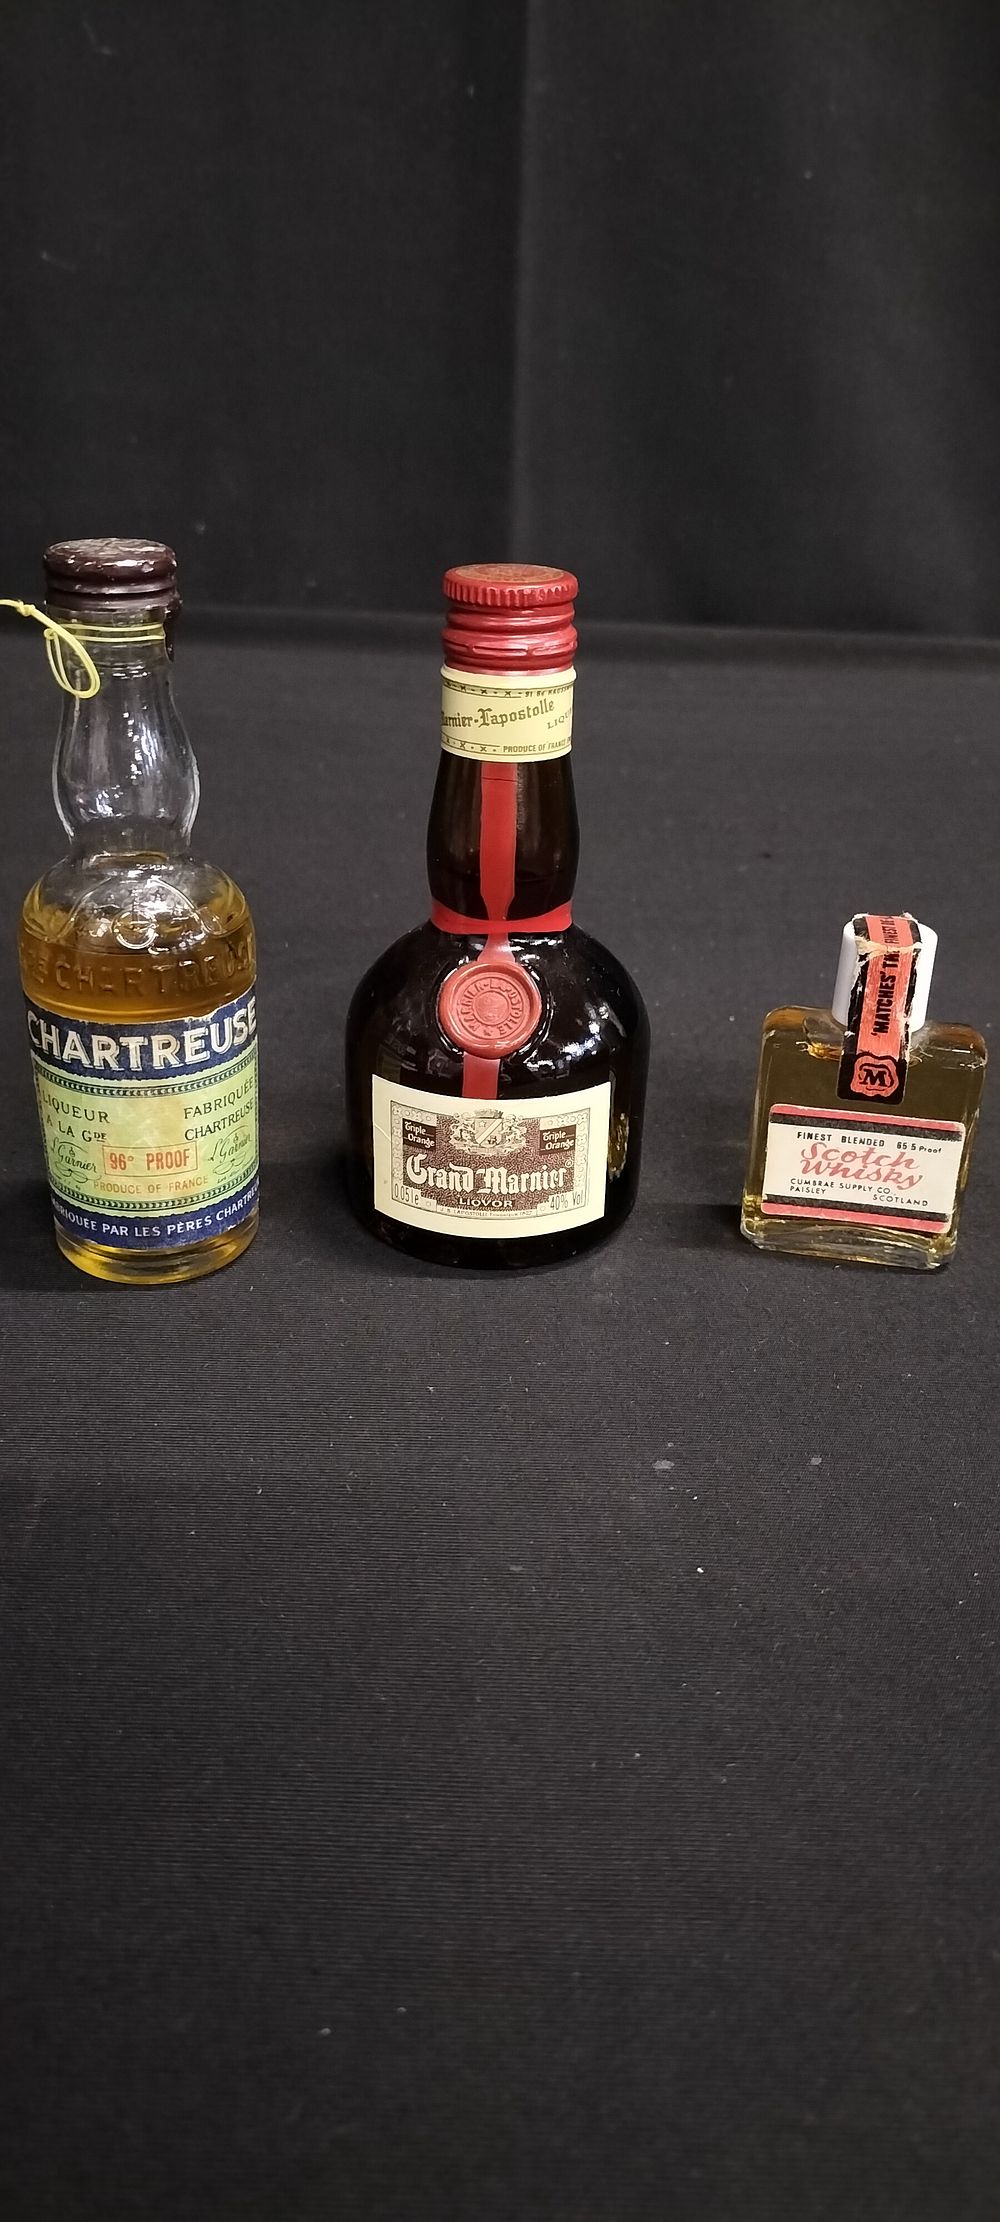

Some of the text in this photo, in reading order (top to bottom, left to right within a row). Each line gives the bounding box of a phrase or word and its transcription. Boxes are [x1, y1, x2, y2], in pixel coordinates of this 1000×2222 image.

[503, 744, 536, 753] PRODUCE
[538, 743, 546, 752] OF
[26, 998, 257, 1071] CHARTREUSE
[864, 1069, 887, 1087] M
[42, 1090, 110, 1124] LIQUEUR
[184, 1076, 254, 1120] FABRIQUÉE
[58, 1120, 75, 1138] LA
[184, 1097, 254, 1141] CHARTREUSE
[404, 1121, 427, 1136] Triple
[407, 1133, 436, 1149] Orange
[542, 1130, 567, 1143] Triple
[545, 1138, 575, 1151] Orange
[797, 1131, 832, 1142] FINEST
[841, 1135, 885, 1147] BLENDED
[918, 1145, 942, 1154] Proof
[146, 1149, 190, 1171] PROOF
[800, 1142, 920, 1170] Scotch
[406, 1153, 567, 1195] Grand Marnier
[800, 1159, 923, 1191] Whisky
[93, 1180, 142, 1195] PRODUCE
[147, 1184, 162, 1194] OF
[168, 1175, 208, 1193] FRANCE
[789, 1185, 827, 1195] PAISLEY
[790, 1178, 835, 1189] CUMBRAE
[839, 1182, 873, 1193] SUPPLY
[872, 1193, 929, 1207] SCOTLAND
[102, 1223, 129, 1236] PAR
[134, 1226, 161, 1237] LES
[166, 1216, 213, 1236] PÈRES
[215, 1184, 260, 1221] CHARTREU
